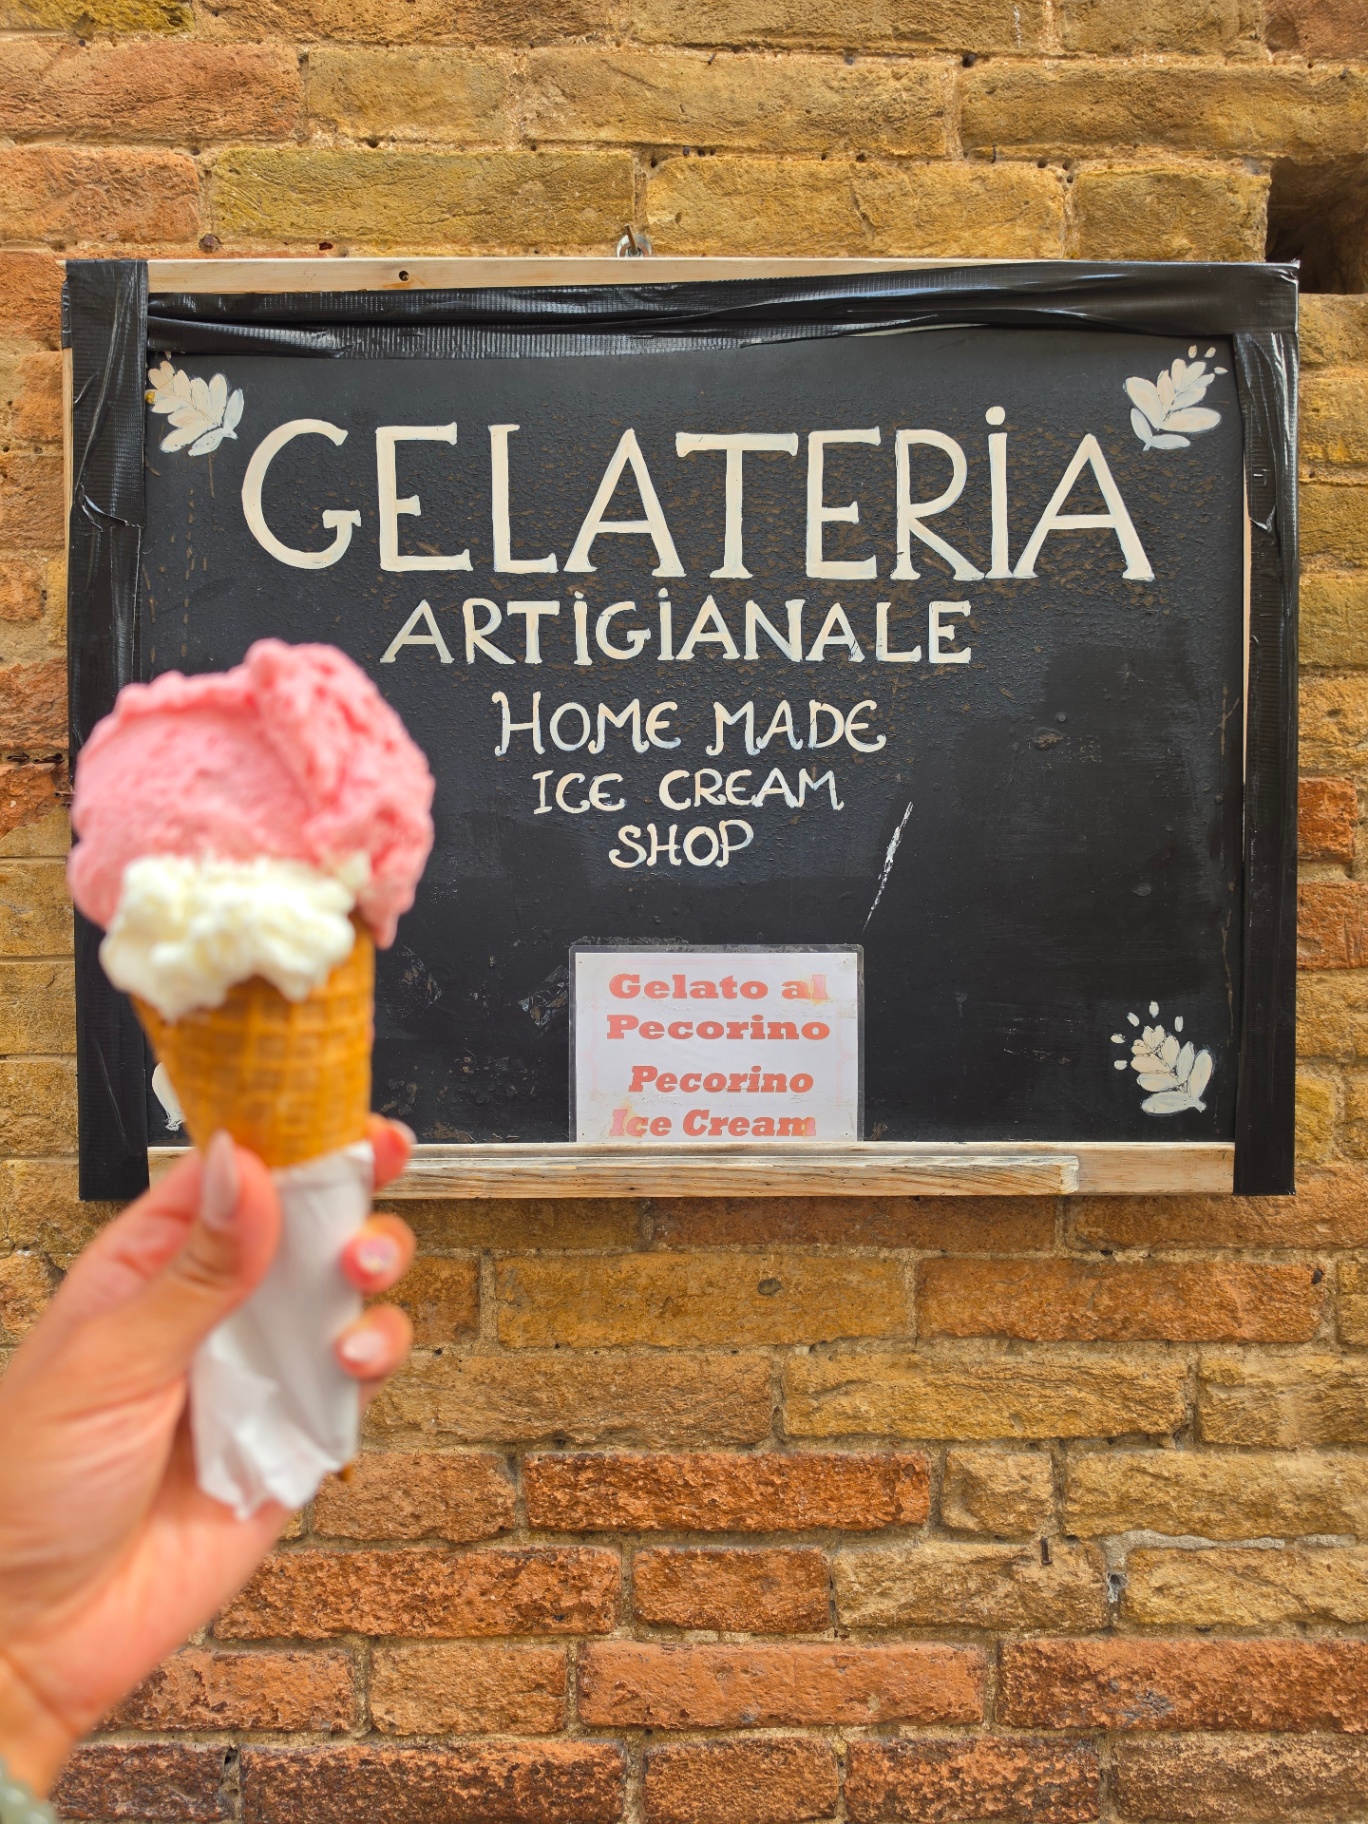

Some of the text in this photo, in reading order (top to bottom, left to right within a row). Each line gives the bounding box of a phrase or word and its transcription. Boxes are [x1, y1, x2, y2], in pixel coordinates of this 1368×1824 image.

[491, 691, 887, 756] HOME MADE
[532, 767, 845, 814] ICE CREAM
[608, 819, 754, 868] SHOP
[608, 973, 829, 1000] Gelato al
[606, 1014, 831, 1041] Pecorino
[628, 1065, 814, 1094] Pecorino
[609, 1109, 817, 1137] Ice Cream
